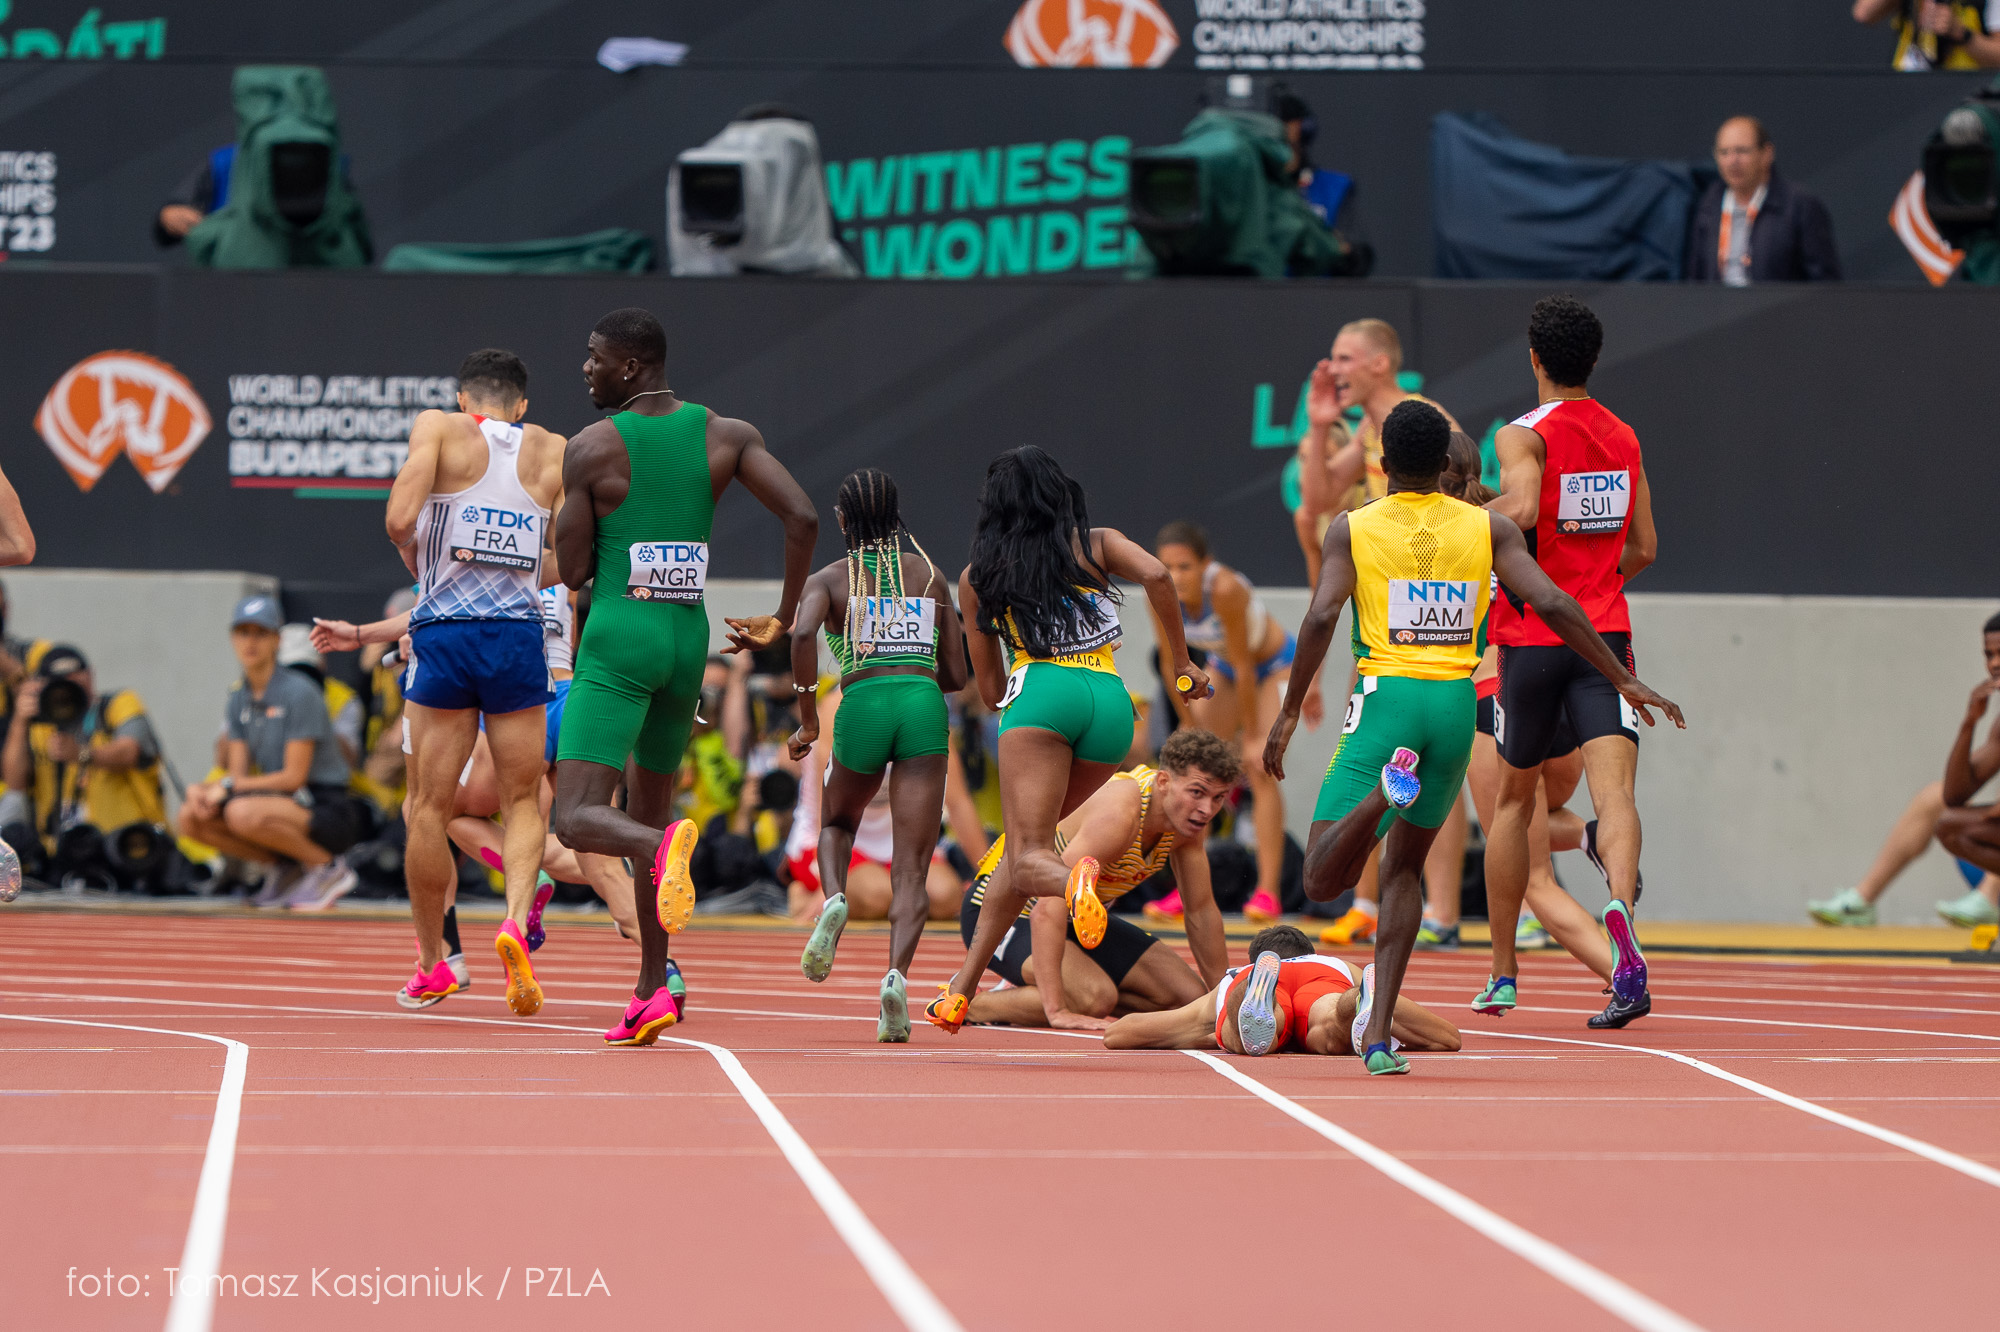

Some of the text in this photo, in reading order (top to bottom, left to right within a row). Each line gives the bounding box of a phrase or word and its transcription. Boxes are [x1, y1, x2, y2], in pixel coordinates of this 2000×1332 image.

[1193, 20, 1426, 53] CHAMPIONSHIPS
[826, 135, 1132, 221] WITNESS
[228, 374, 458, 407] WORLD ATHLETICS
[229, 440, 410, 477] BUDAPEST
[1580, 474, 1626, 492] TDK
[1580, 496, 1611, 516] SUI
[480, 507, 535, 532] TDK
[1581, 520, 1620, 530] BUDAPEST
[473, 529, 518, 552] FRA
[476, 552, 532, 568] BUDAPEST 23
[654, 545, 705, 562] TDK
[648, 568, 698, 586] NGR
[654, 591, 700, 600] BUDAPEST
[1408, 582, 1466, 603] NTN
[1410, 607, 1462, 628] JAM
[871, 620, 920, 640] NGR
[1108, 629, 1118, 639] 23
[1418, 632, 1470, 642] BUDAPEST 23
[878, 645, 922, 653] BUDAPEST
[1008, 676, 1017, 700] 2
